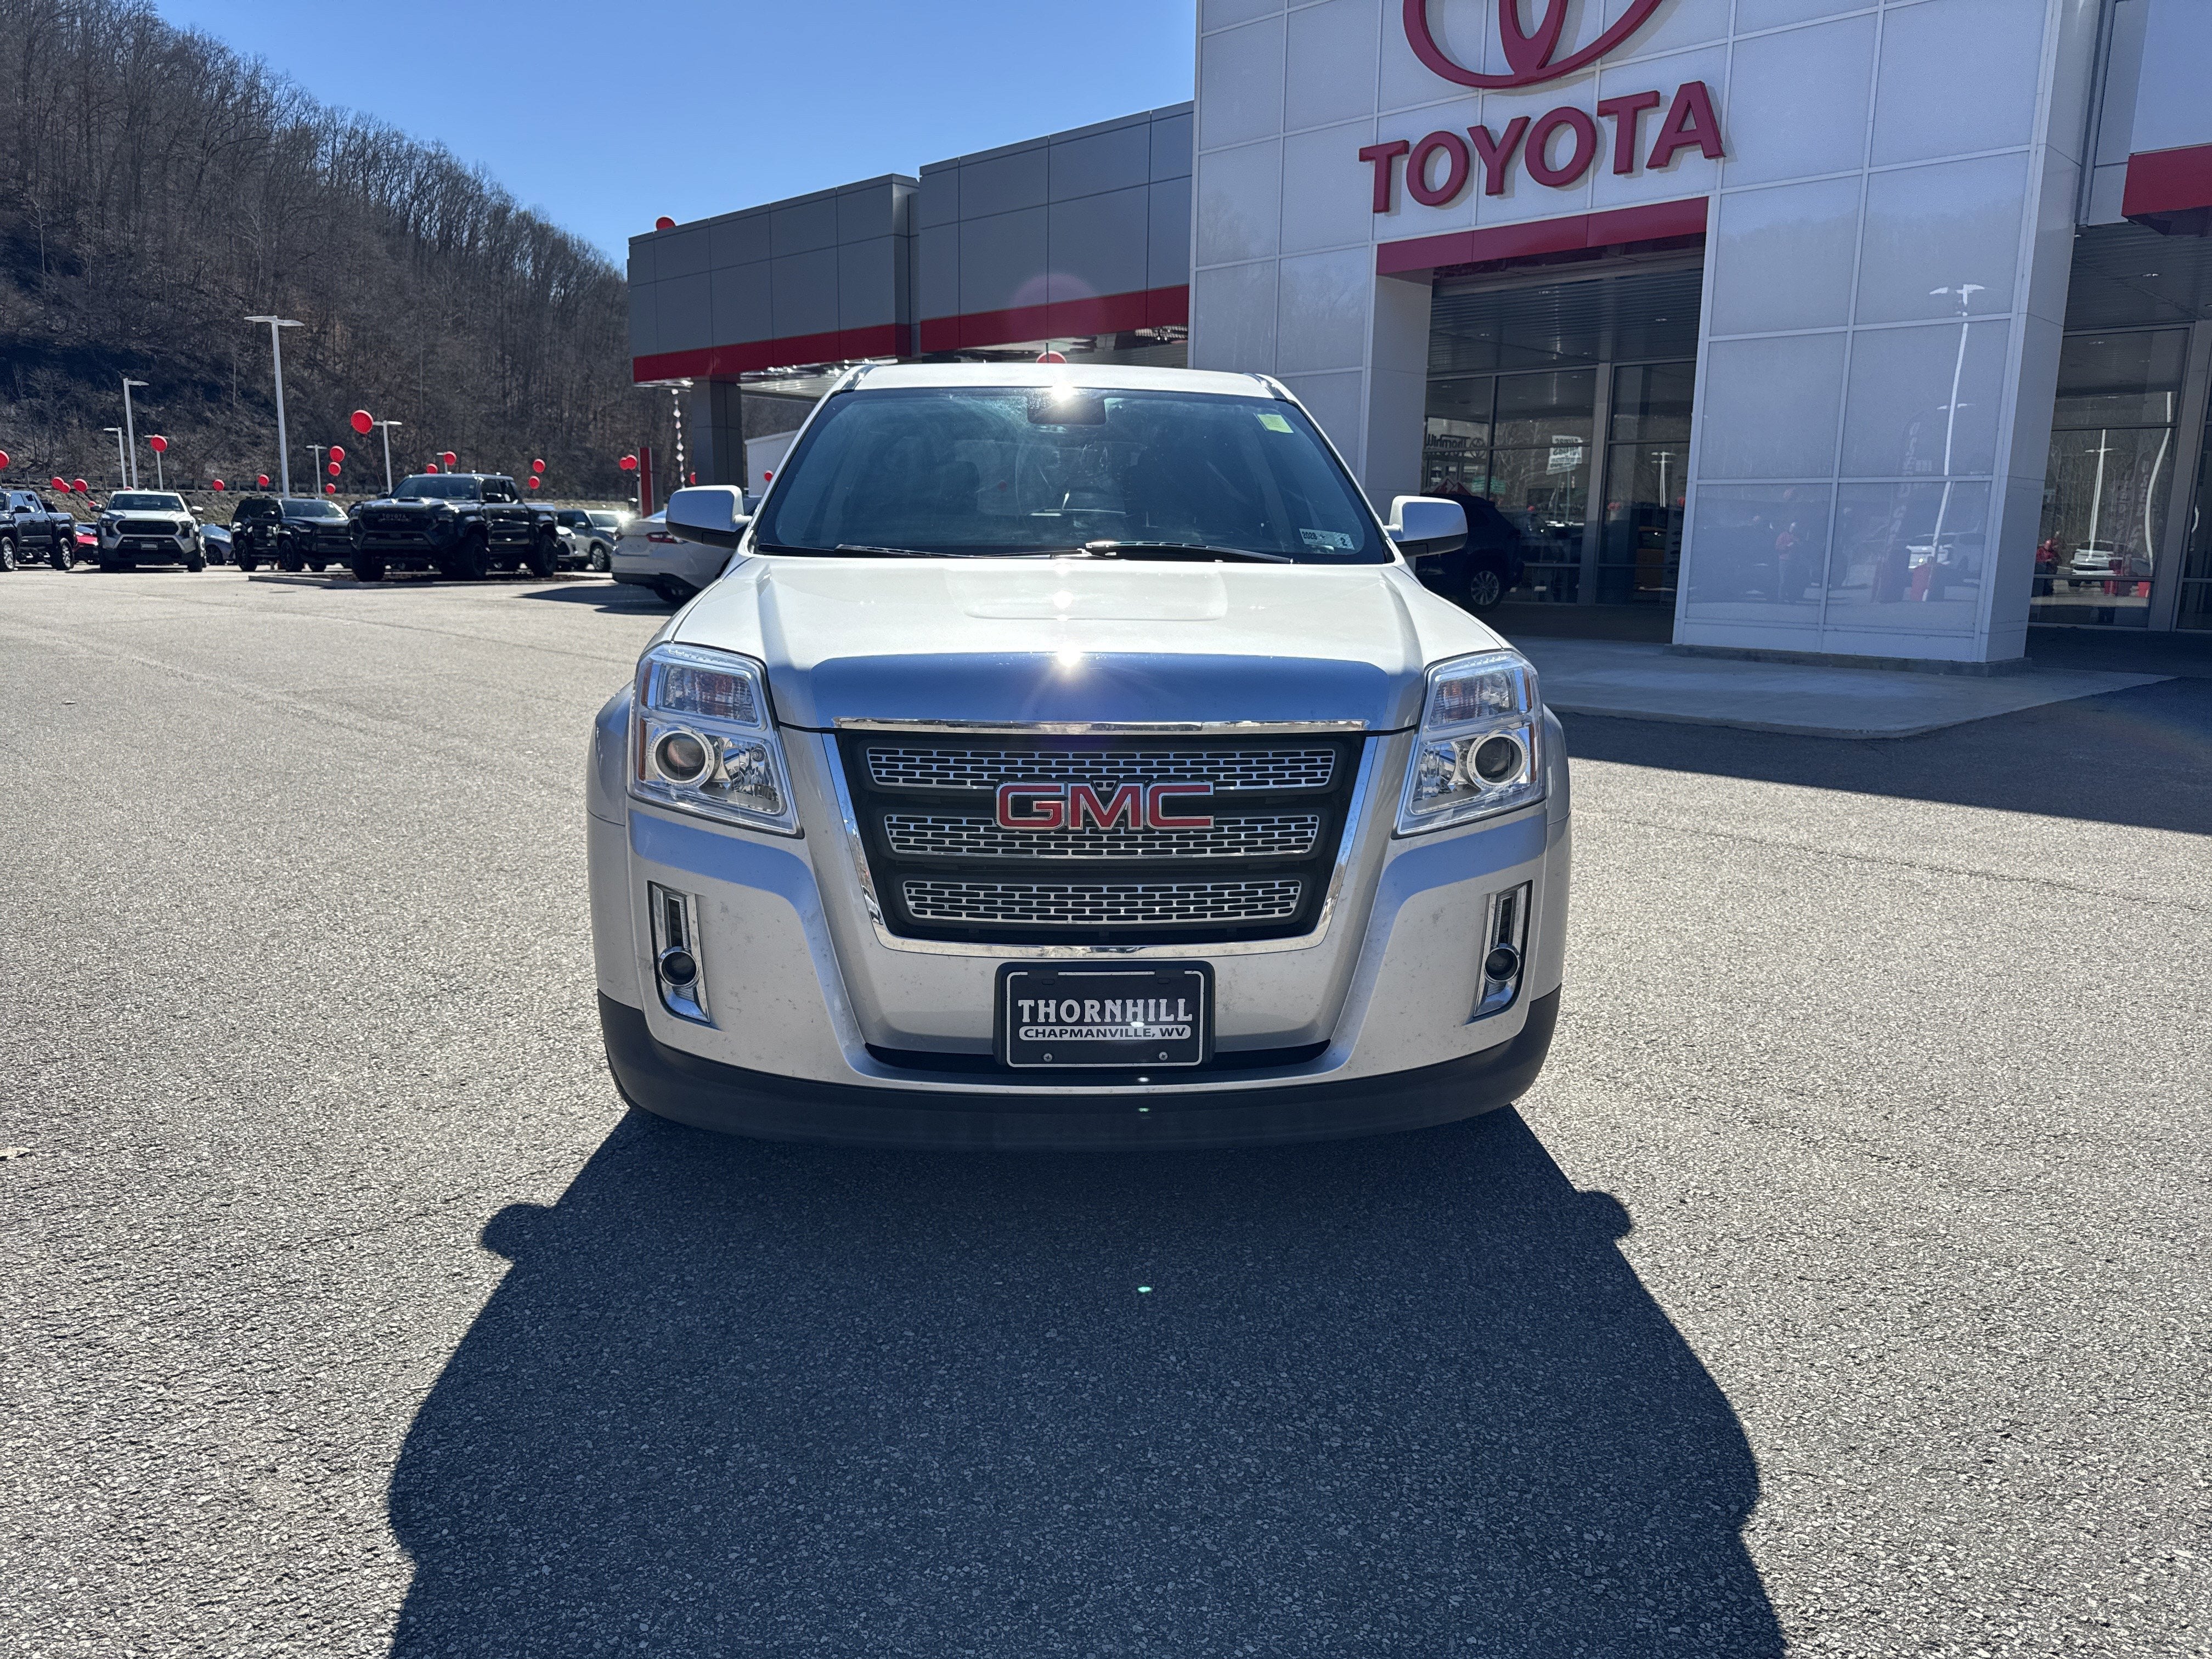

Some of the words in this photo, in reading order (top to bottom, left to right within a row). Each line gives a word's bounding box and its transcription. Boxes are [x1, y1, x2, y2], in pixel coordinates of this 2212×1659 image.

[1358, 80, 1726, 213] TOYOTA
[1340, 537, 1347, 546] 2
[995, 780, 1215, 832] GMC
[1018, 998, 1193, 1023] THORNHILL
[1024, 1028, 1156, 1039] CHAPMANVILLE,
[1159, 1027, 1186, 1037] WV
